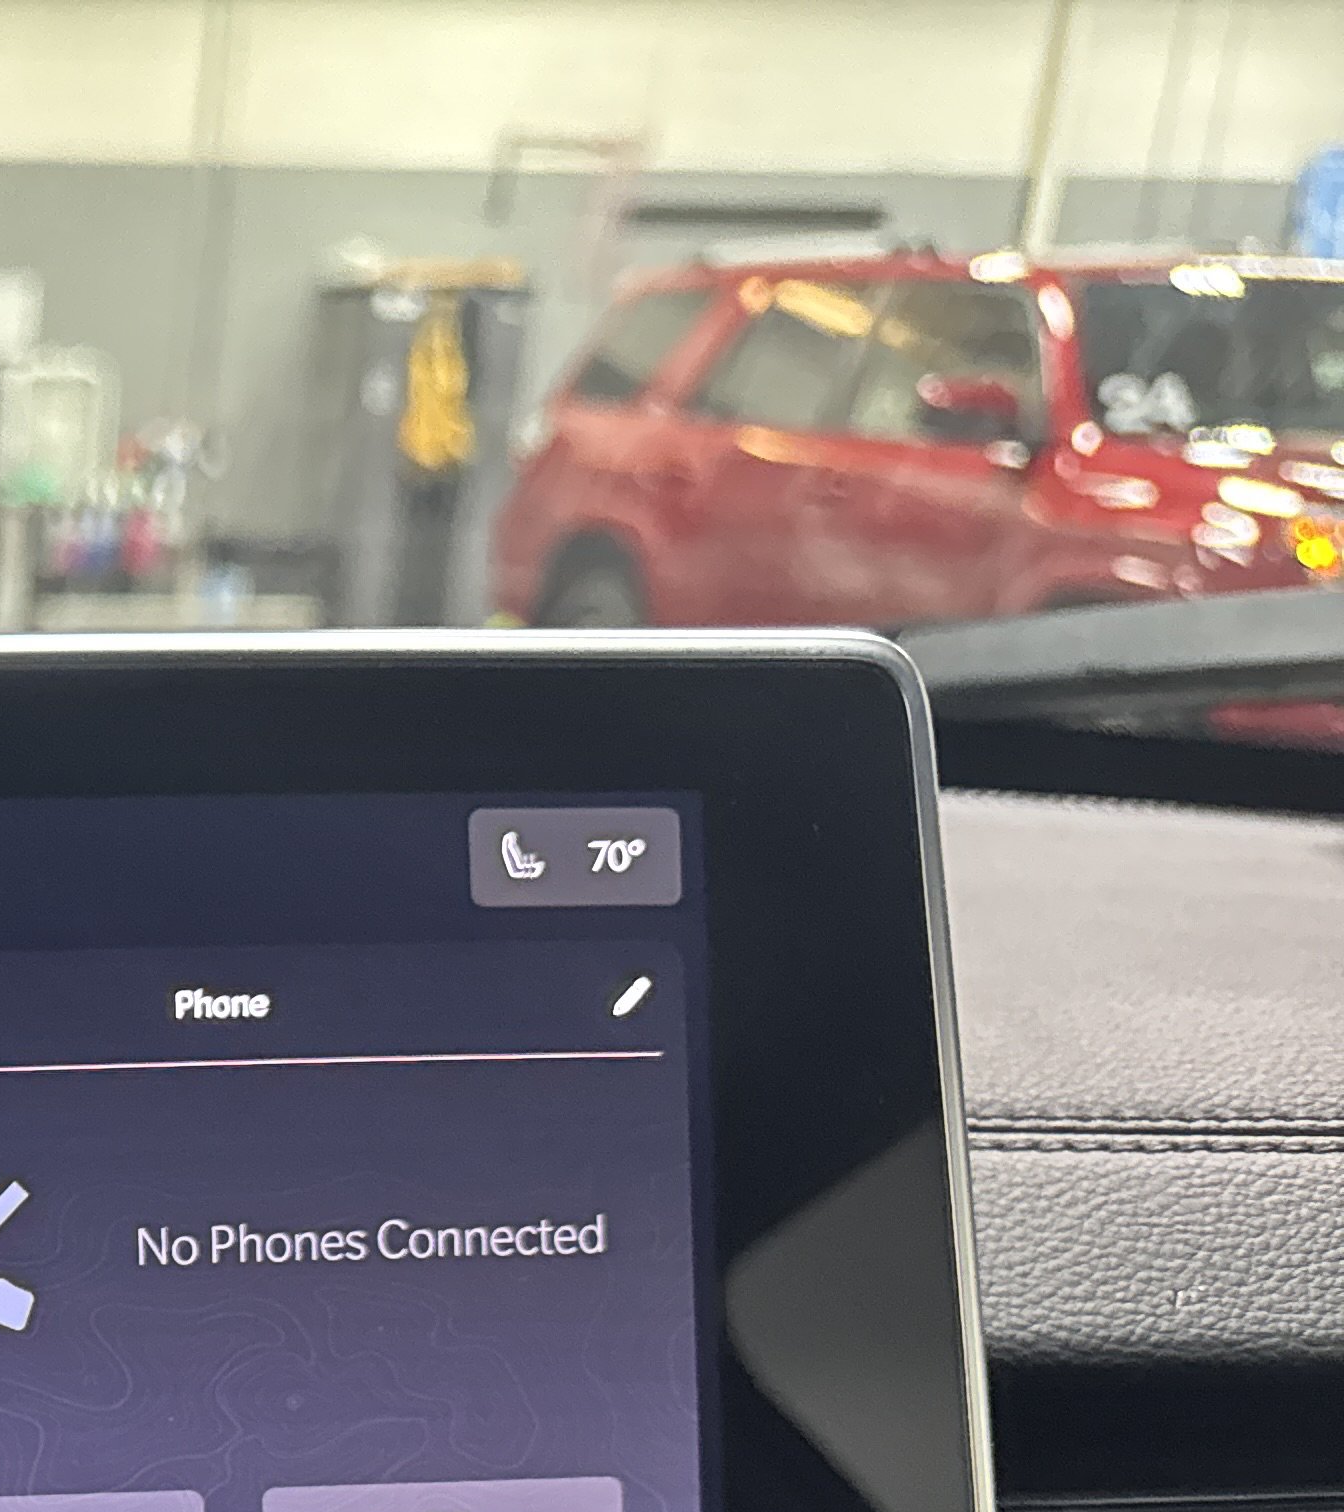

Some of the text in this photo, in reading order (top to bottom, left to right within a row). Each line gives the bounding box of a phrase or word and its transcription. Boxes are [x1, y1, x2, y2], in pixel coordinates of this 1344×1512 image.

[173, 987, 272, 1021] Phone
[136, 1213, 606, 1267] No Phones Connected
